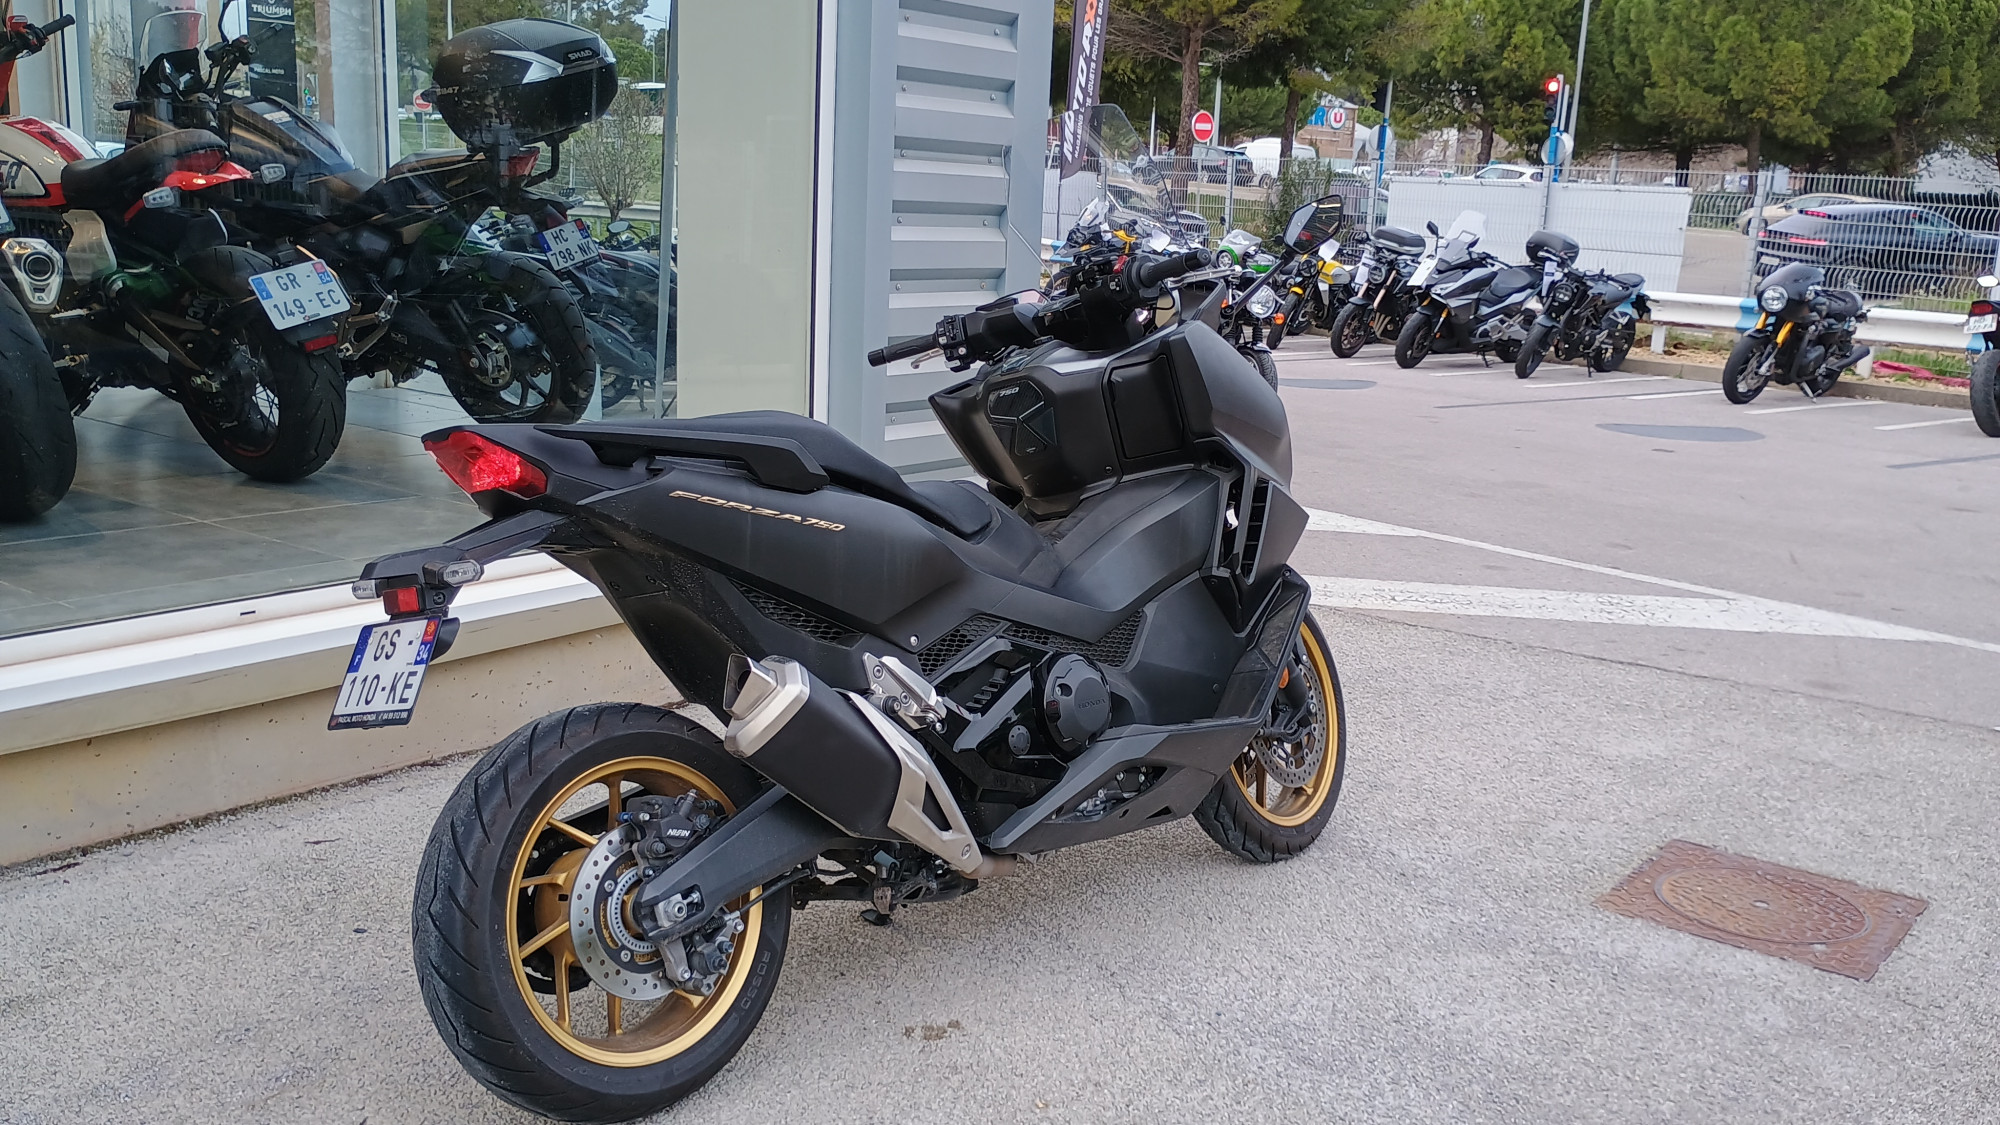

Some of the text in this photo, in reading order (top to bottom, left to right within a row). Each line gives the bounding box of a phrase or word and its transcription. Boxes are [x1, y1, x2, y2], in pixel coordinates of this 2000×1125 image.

[251, 4, 292, 17] TRIUMPH
[568, 50, 593, 60] SHAD
[1091, 35, 1099, 61] POUR
[551, 240, 595, 267] 798-NK
[319, 273, 332, 283] 34
[273, 289, 341, 320] 149-EC
[1000, 386, 1020, 397] 750
[416, 643, 430, 661] 34
[344, 670, 418, 708] 110-KE
[1078, 698, 1106, 709] HONDA
